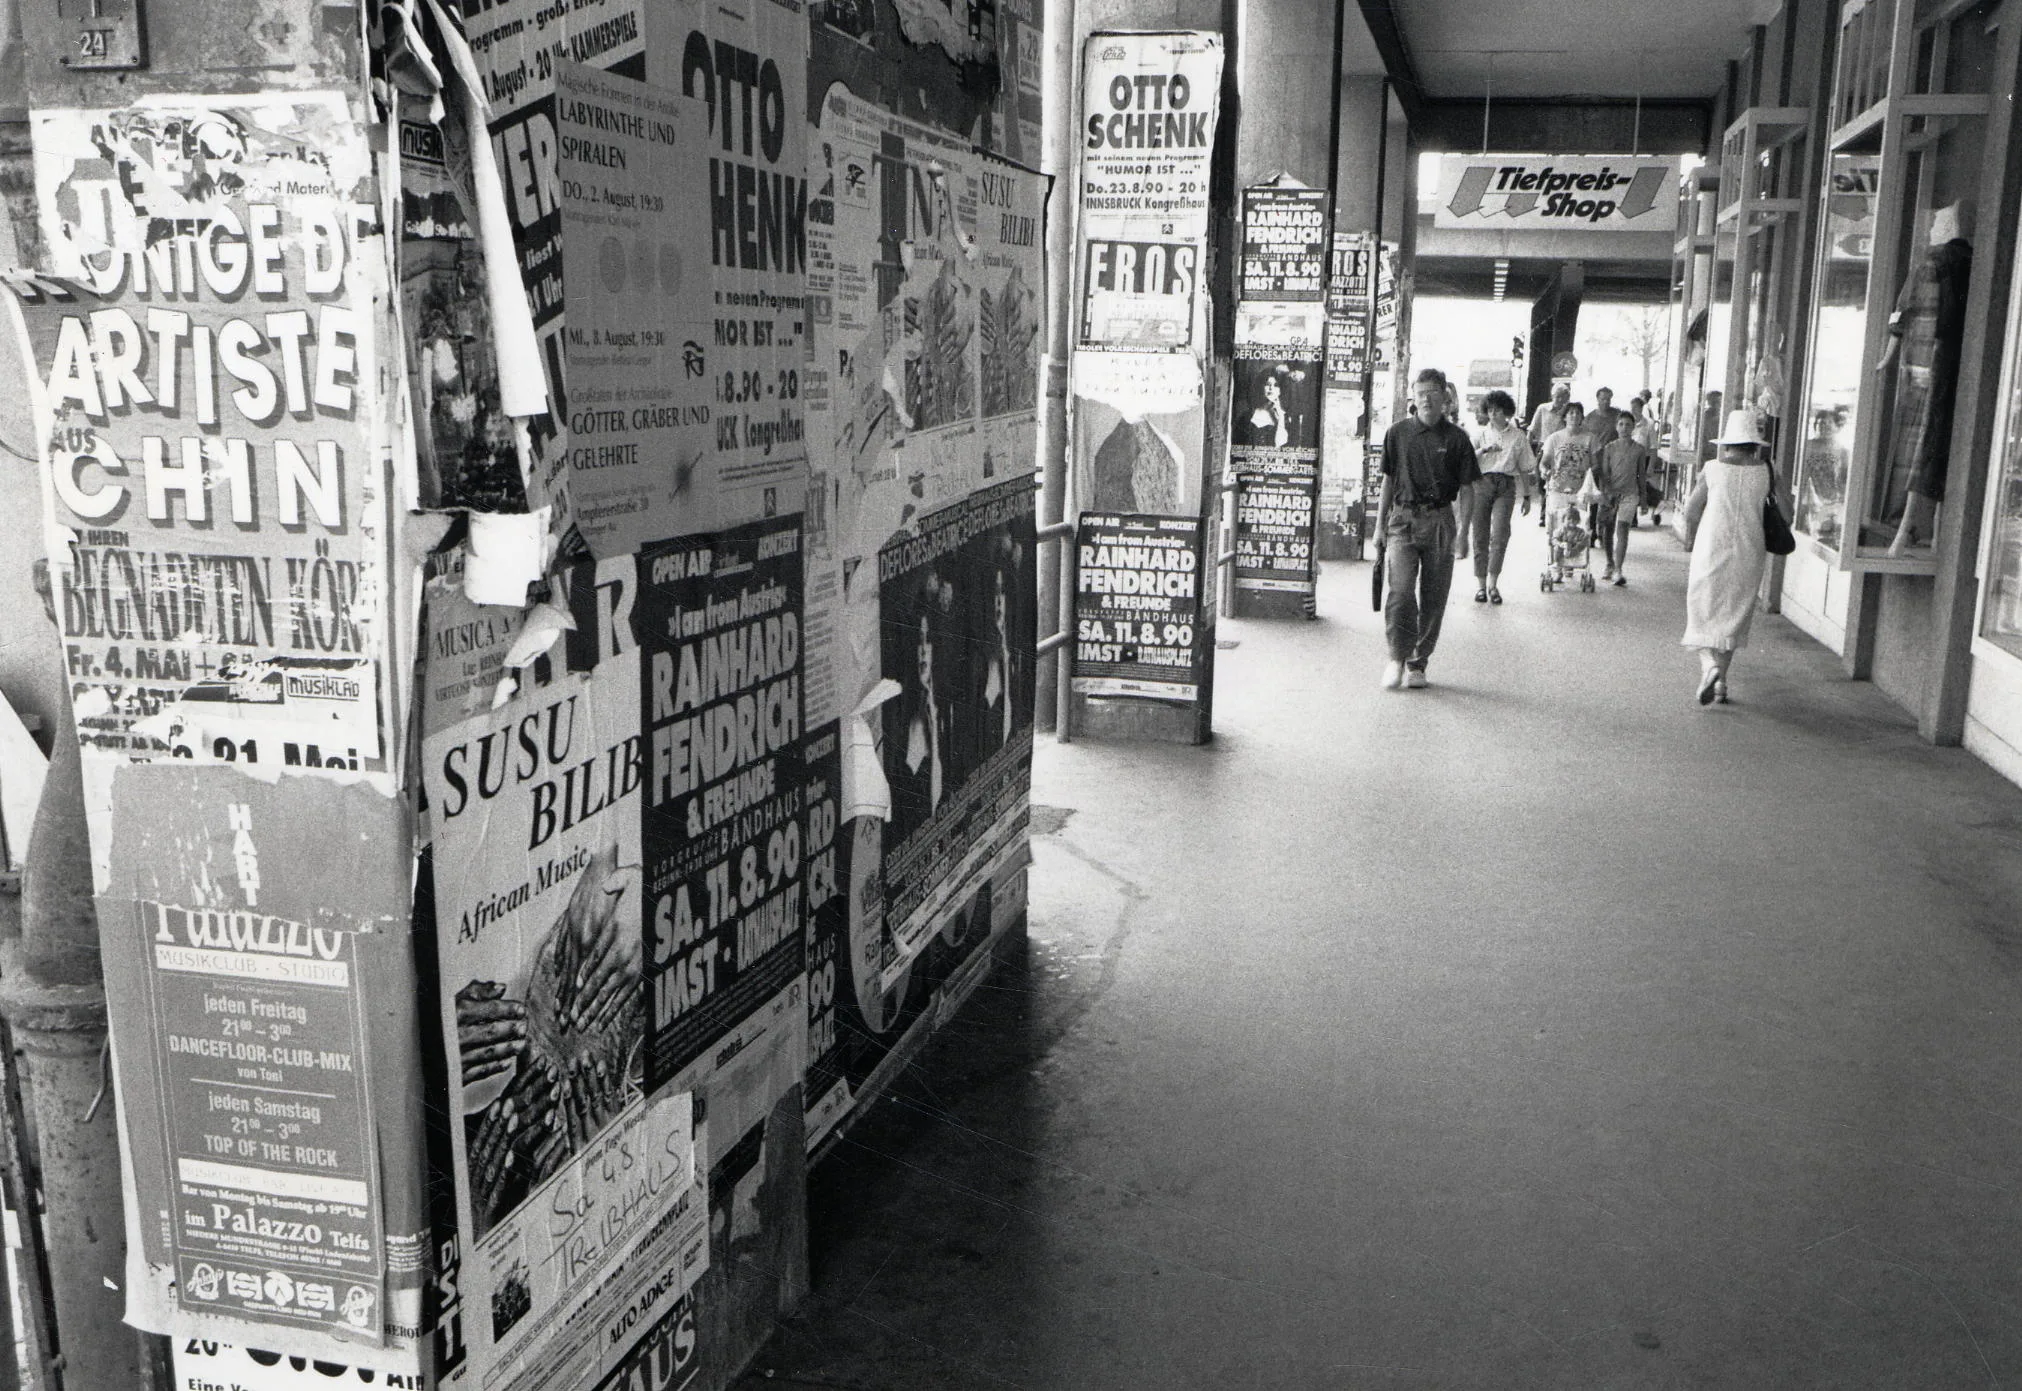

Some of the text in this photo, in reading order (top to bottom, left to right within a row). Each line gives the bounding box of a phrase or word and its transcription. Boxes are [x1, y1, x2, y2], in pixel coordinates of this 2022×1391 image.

[79, 30, 109, 58] 24
[570, 10, 638, 64] KAMMERSPIELE
[1108, 73, 1191, 111] OTTO
[559, 97, 676, 146] LABYRINTHE UND
[1086, 112, 1208, 150] SCHENK
[561, 135, 627, 170] SPIRALEN
[1103, 154, 1134, 162] seinem
[1157, 165, 1176, 175] IST
[1496, 166, 1632, 196] Tiefpreis-
[980, 170, 1016, 209] SUSU
[1085, 196, 1142, 210] INNSBRUCK
[1246, 211, 1323, 227] RAINHARD
[1540, 192, 1617, 223] Shop
[999, 212, 1036, 247] BILIBI
[1246, 226, 1322, 244] FENDRICH
[1088, 242, 1194, 301] EROS
[753, 320, 774, 347] IST
[778, 368, 798, 401] 20
[571, 403, 710, 436] GÖTTER, GRÄBER UND
[572, 443, 639, 471] GELEHRTE
[1237, 507, 1312, 527] FENDRICH
[1238, 493, 1312, 511] RAINHARD
[1081, 516, 1104, 527] OPEN
[88, 530, 129, 547] IHREN
[1118, 533, 1143, 546] from
[652, 552, 686, 586] OPEN
[687, 549, 713, 578] AIR
[1079, 545, 1196, 572] RAINHARD
[1236, 552, 1264, 568] IMST
[1079, 568, 1195, 598] FENDRICH
[1101, 594, 1172, 611] & FREUNDE
[135, 646, 192, 681] MAI
[651, 610, 799, 723] RAINHARD
[1077, 642, 1123, 662] IMST
[651, 674, 800, 808] FENDRICH
[443, 694, 579, 824] SUSU
[703, 758, 776, 833] FREUNDE
[457, 844, 588, 945] African Music
[653, 935, 719, 1034] IMST
[203, 993, 307, 1025] jeden Freitag
[168, 1034, 352, 1073] DANCEFLOOR-CLUB-MIX
[237, 1066, 258, 1080] von
[207, 1090, 321, 1125] jeden Samstag
[203, 1133, 339, 1168] TOP OF THE ROCK
[185, 1202, 371, 1251] im Palazzo Telfs
[608, 1305, 638, 1345] ALTO
[639, 1267, 675, 1312] ADIGE
